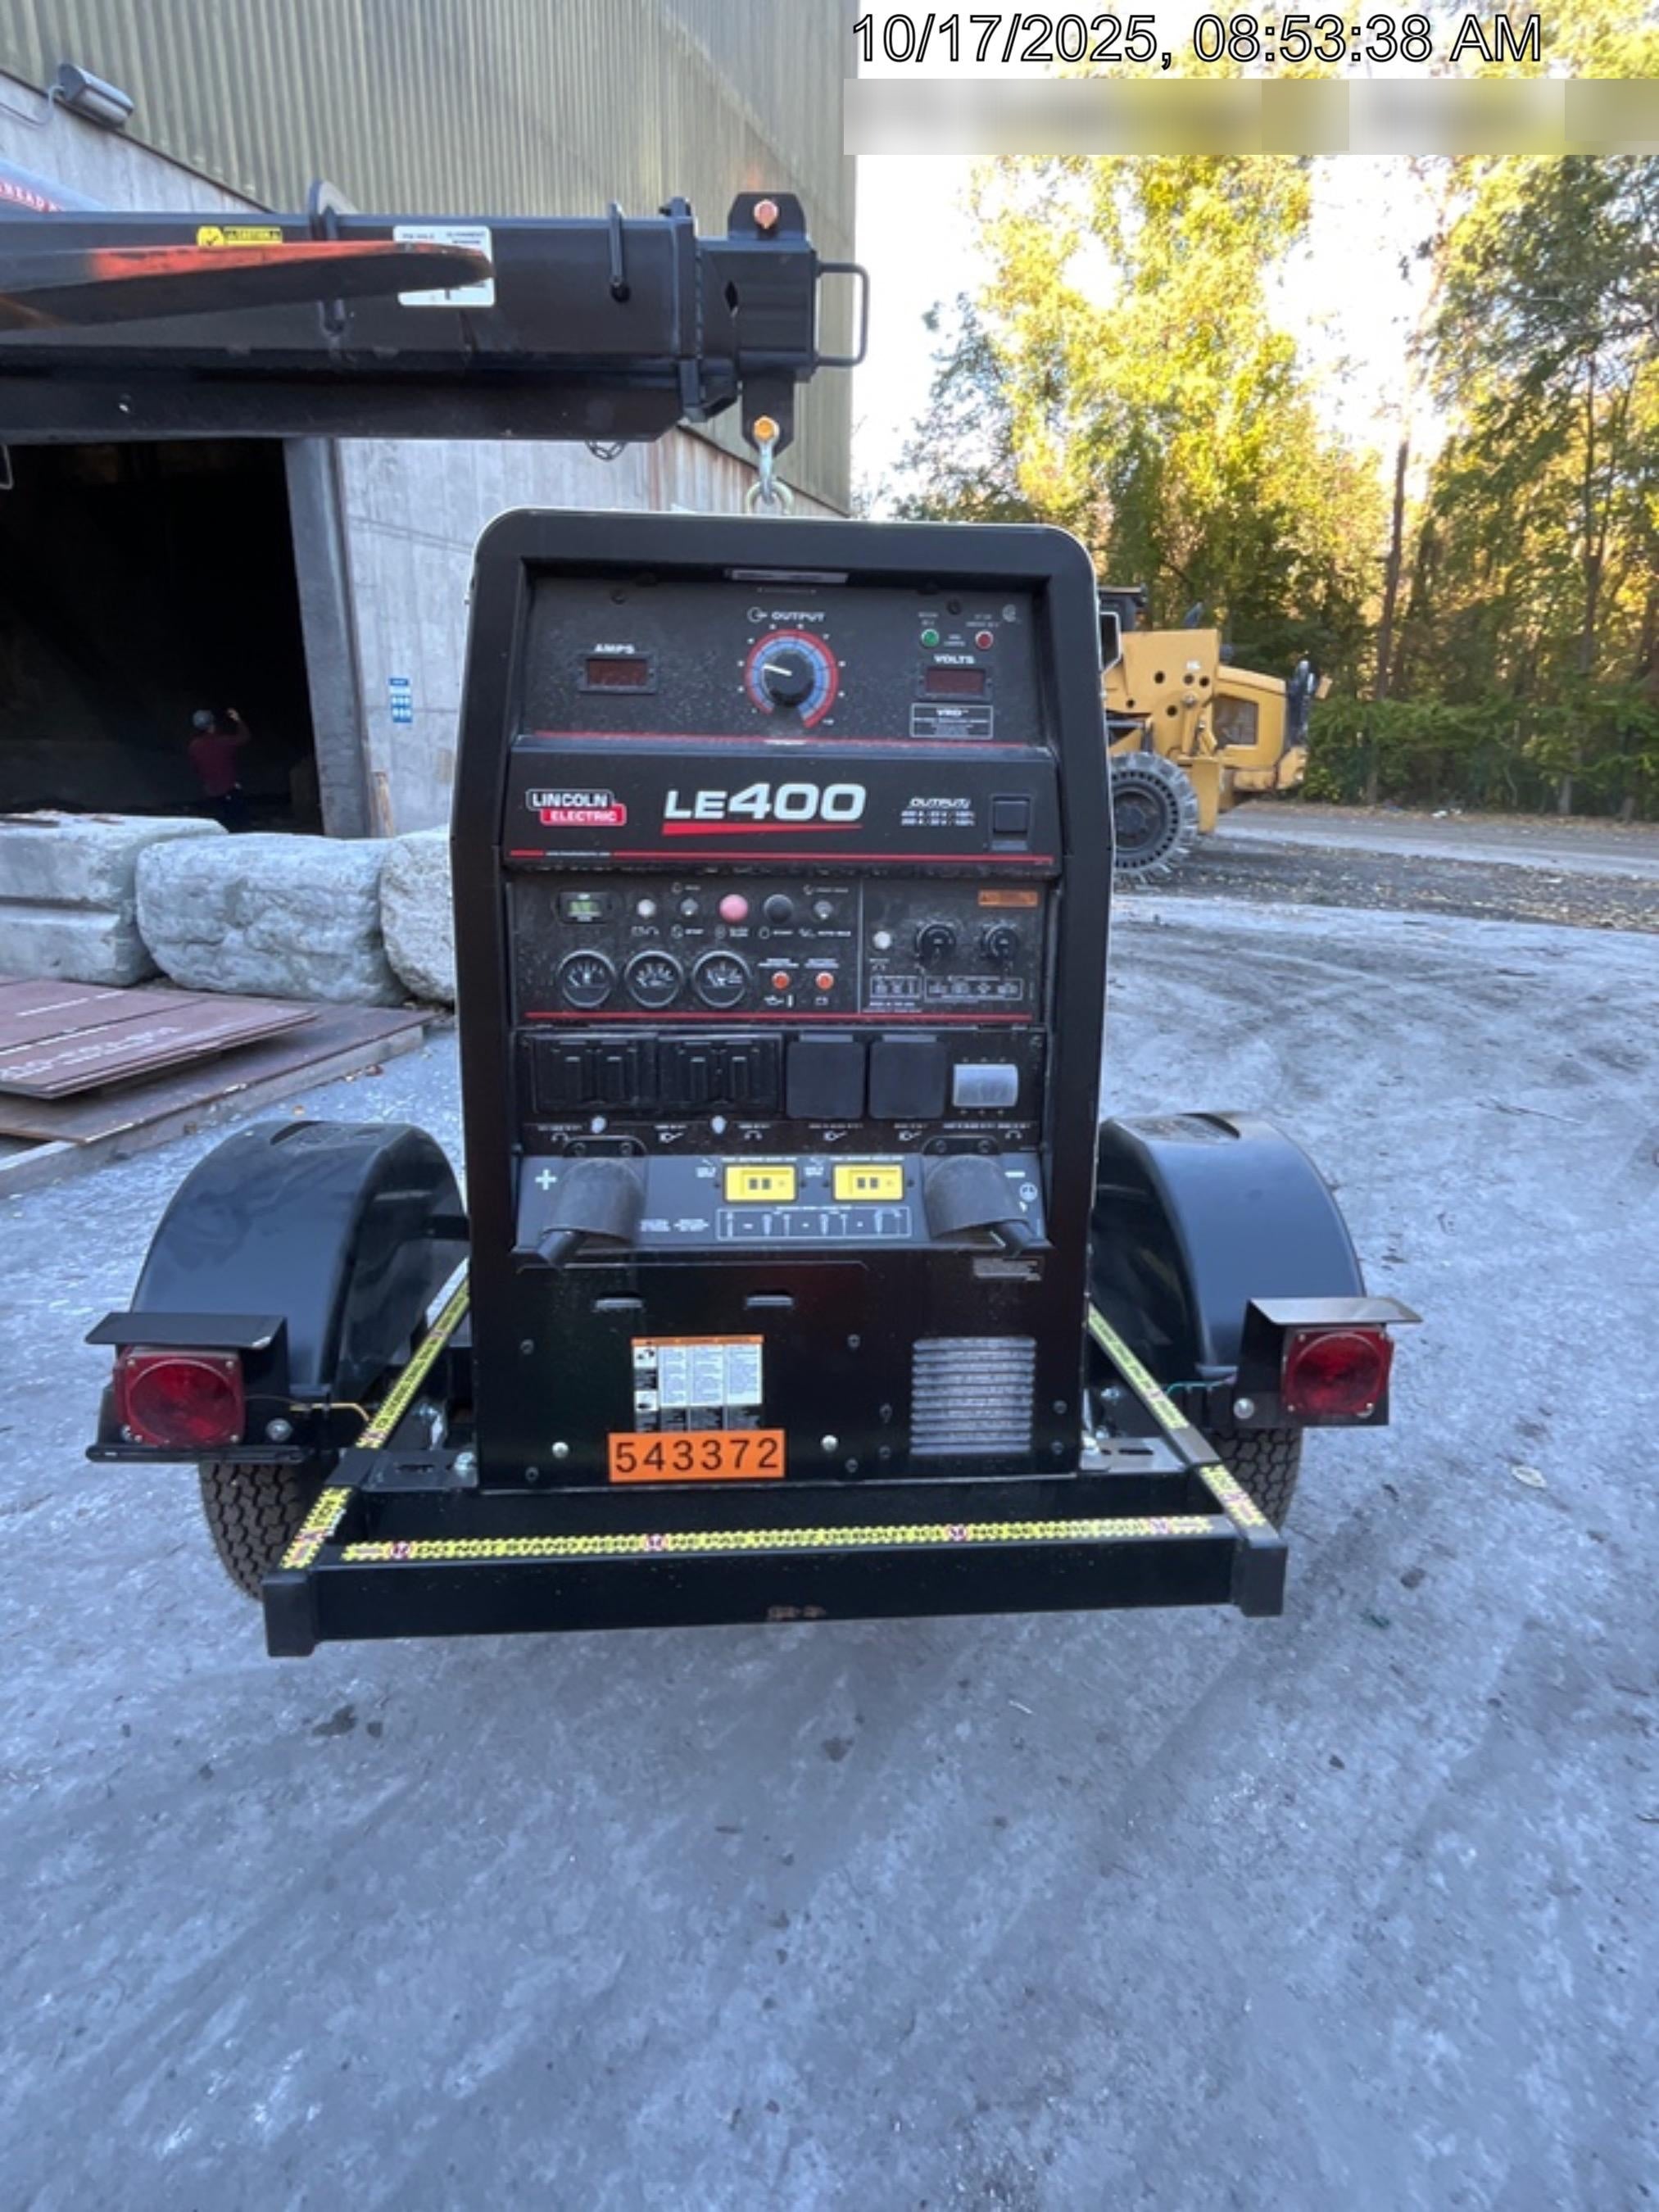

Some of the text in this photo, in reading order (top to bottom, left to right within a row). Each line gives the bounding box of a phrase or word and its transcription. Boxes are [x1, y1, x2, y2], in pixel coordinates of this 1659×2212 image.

[771, 610, 826, 623] OUTPUT
[593, 643, 636, 655] AMPS
[933, 653, 975, 665] VOLTS
[532, 792, 608, 808] LINCOLN
[664, 783, 867, 821] LE400
[550, 809, 617, 822] ELECTRIC
[615, 1437, 778, 1474] 543372
[416, 1542, 449, 1554] DO
[454, 1540, 497, 1553] NOT
